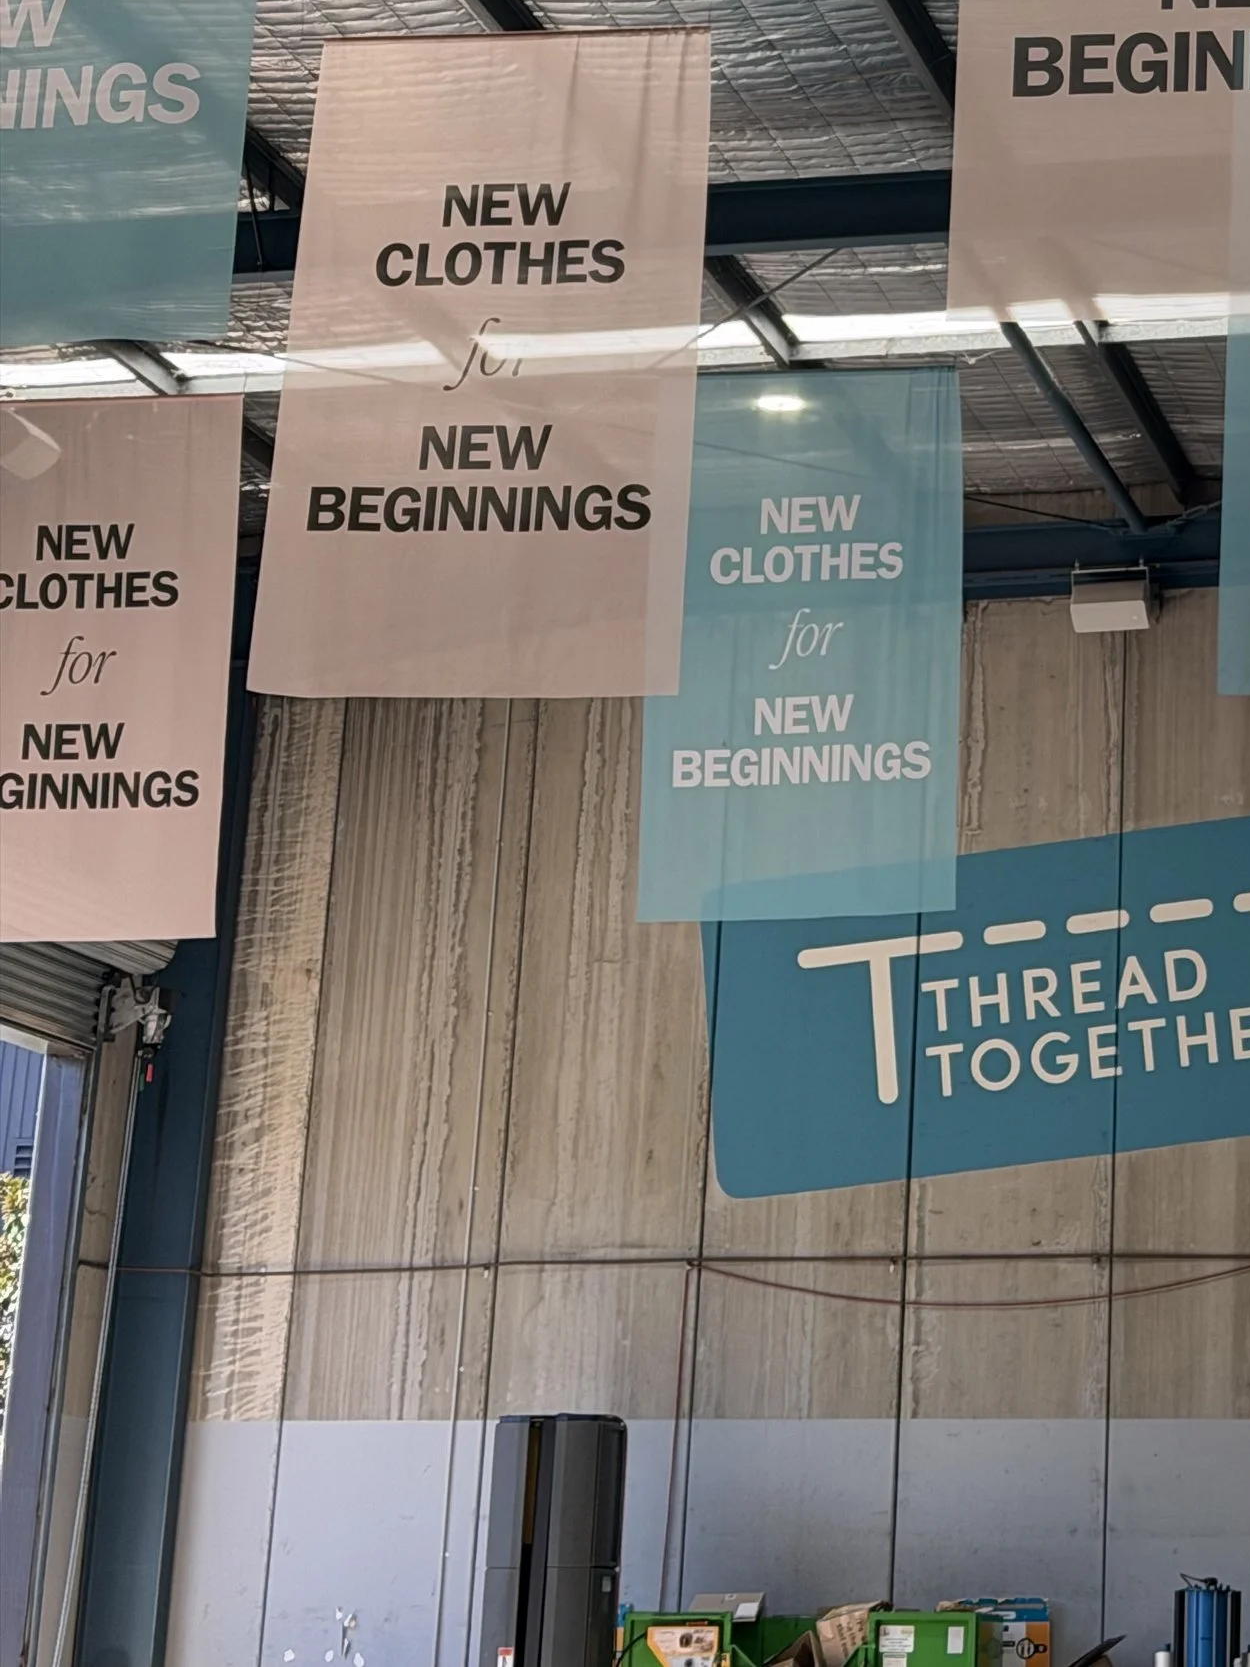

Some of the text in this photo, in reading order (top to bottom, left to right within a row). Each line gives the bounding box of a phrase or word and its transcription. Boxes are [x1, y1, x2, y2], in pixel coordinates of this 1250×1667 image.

[442, 182, 571, 227] NEW
[376, 239, 625, 287] CLOTHES
[419, 424, 552, 471] NEW
[306, 484, 652, 532] BEGINNINGS
[760, 495, 861, 534] NEW
[36, 524, 134, 560] NEW
[710, 542, 903, 584] CLOTHES
[768, 608, 844, 670] for
[40, 636, 117, 695] for
[754, 694, 853, 735] NEW
[22, 722, 125, 760] NEW
[672, 741, 931, 787] BEGINNINGS
[921, 948, 1208, 1033] THREAD
